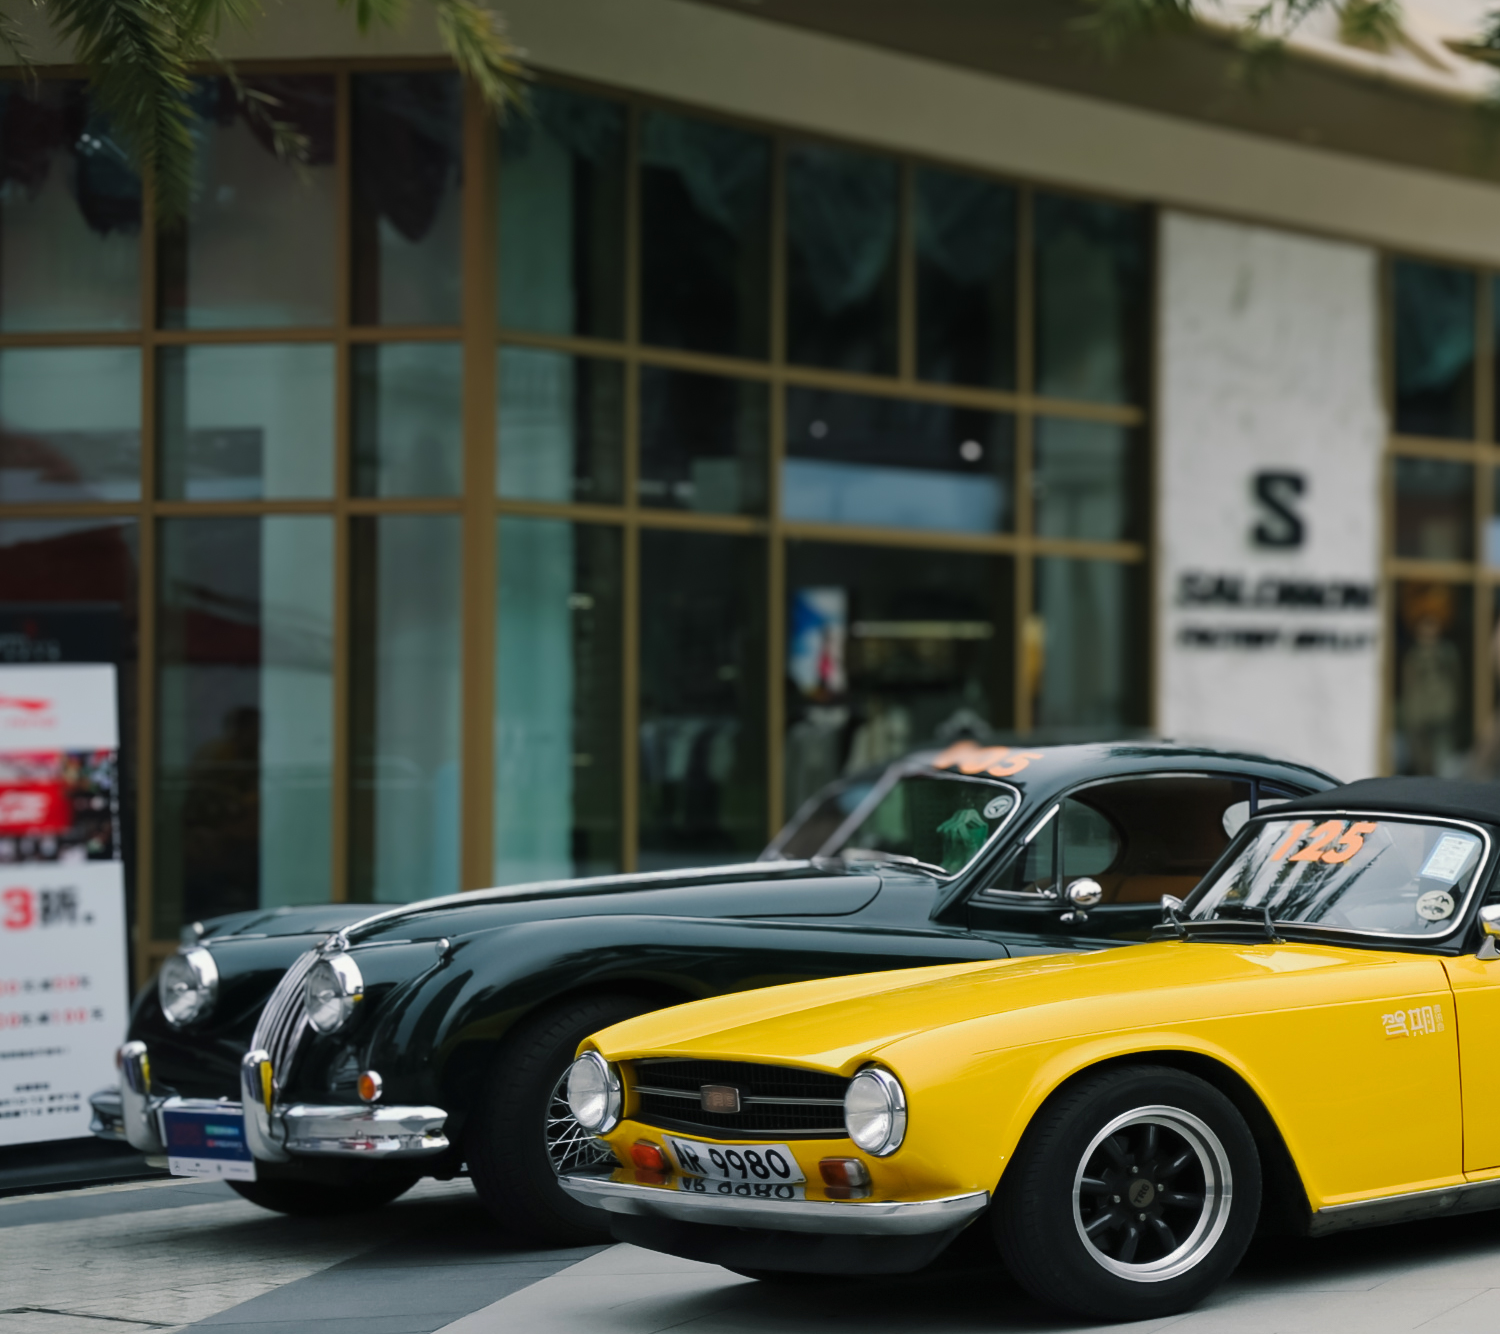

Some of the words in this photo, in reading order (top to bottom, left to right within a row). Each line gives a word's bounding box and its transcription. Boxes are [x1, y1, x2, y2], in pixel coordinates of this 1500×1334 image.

[1253, 472, 1307, 547] S
[1270, 819, 1378, 865] 125
[671, 1140, 708, 1175] AR
[708, 1148, 792, 1181] 9980
